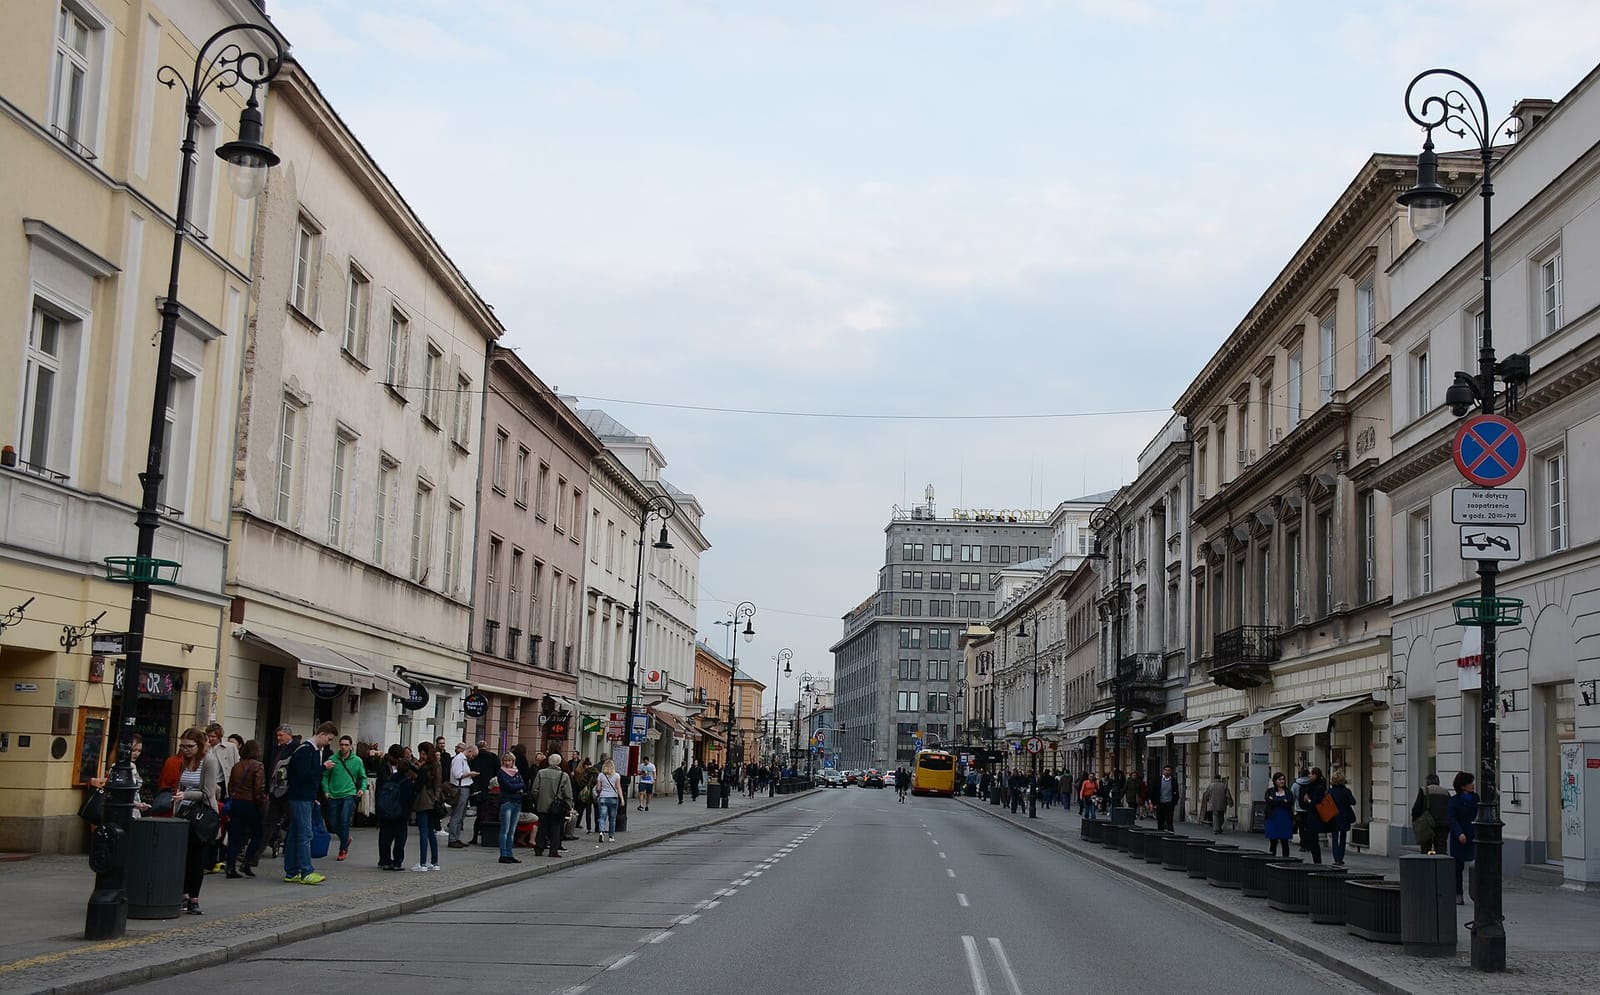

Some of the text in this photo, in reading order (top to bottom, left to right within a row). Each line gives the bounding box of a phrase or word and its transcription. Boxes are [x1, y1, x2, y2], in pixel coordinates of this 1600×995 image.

[1485, 492, 1509, 500] dotyczy
[952, 508, 995, 521] BANK
[1468, 512, 1487, 520] godz.
